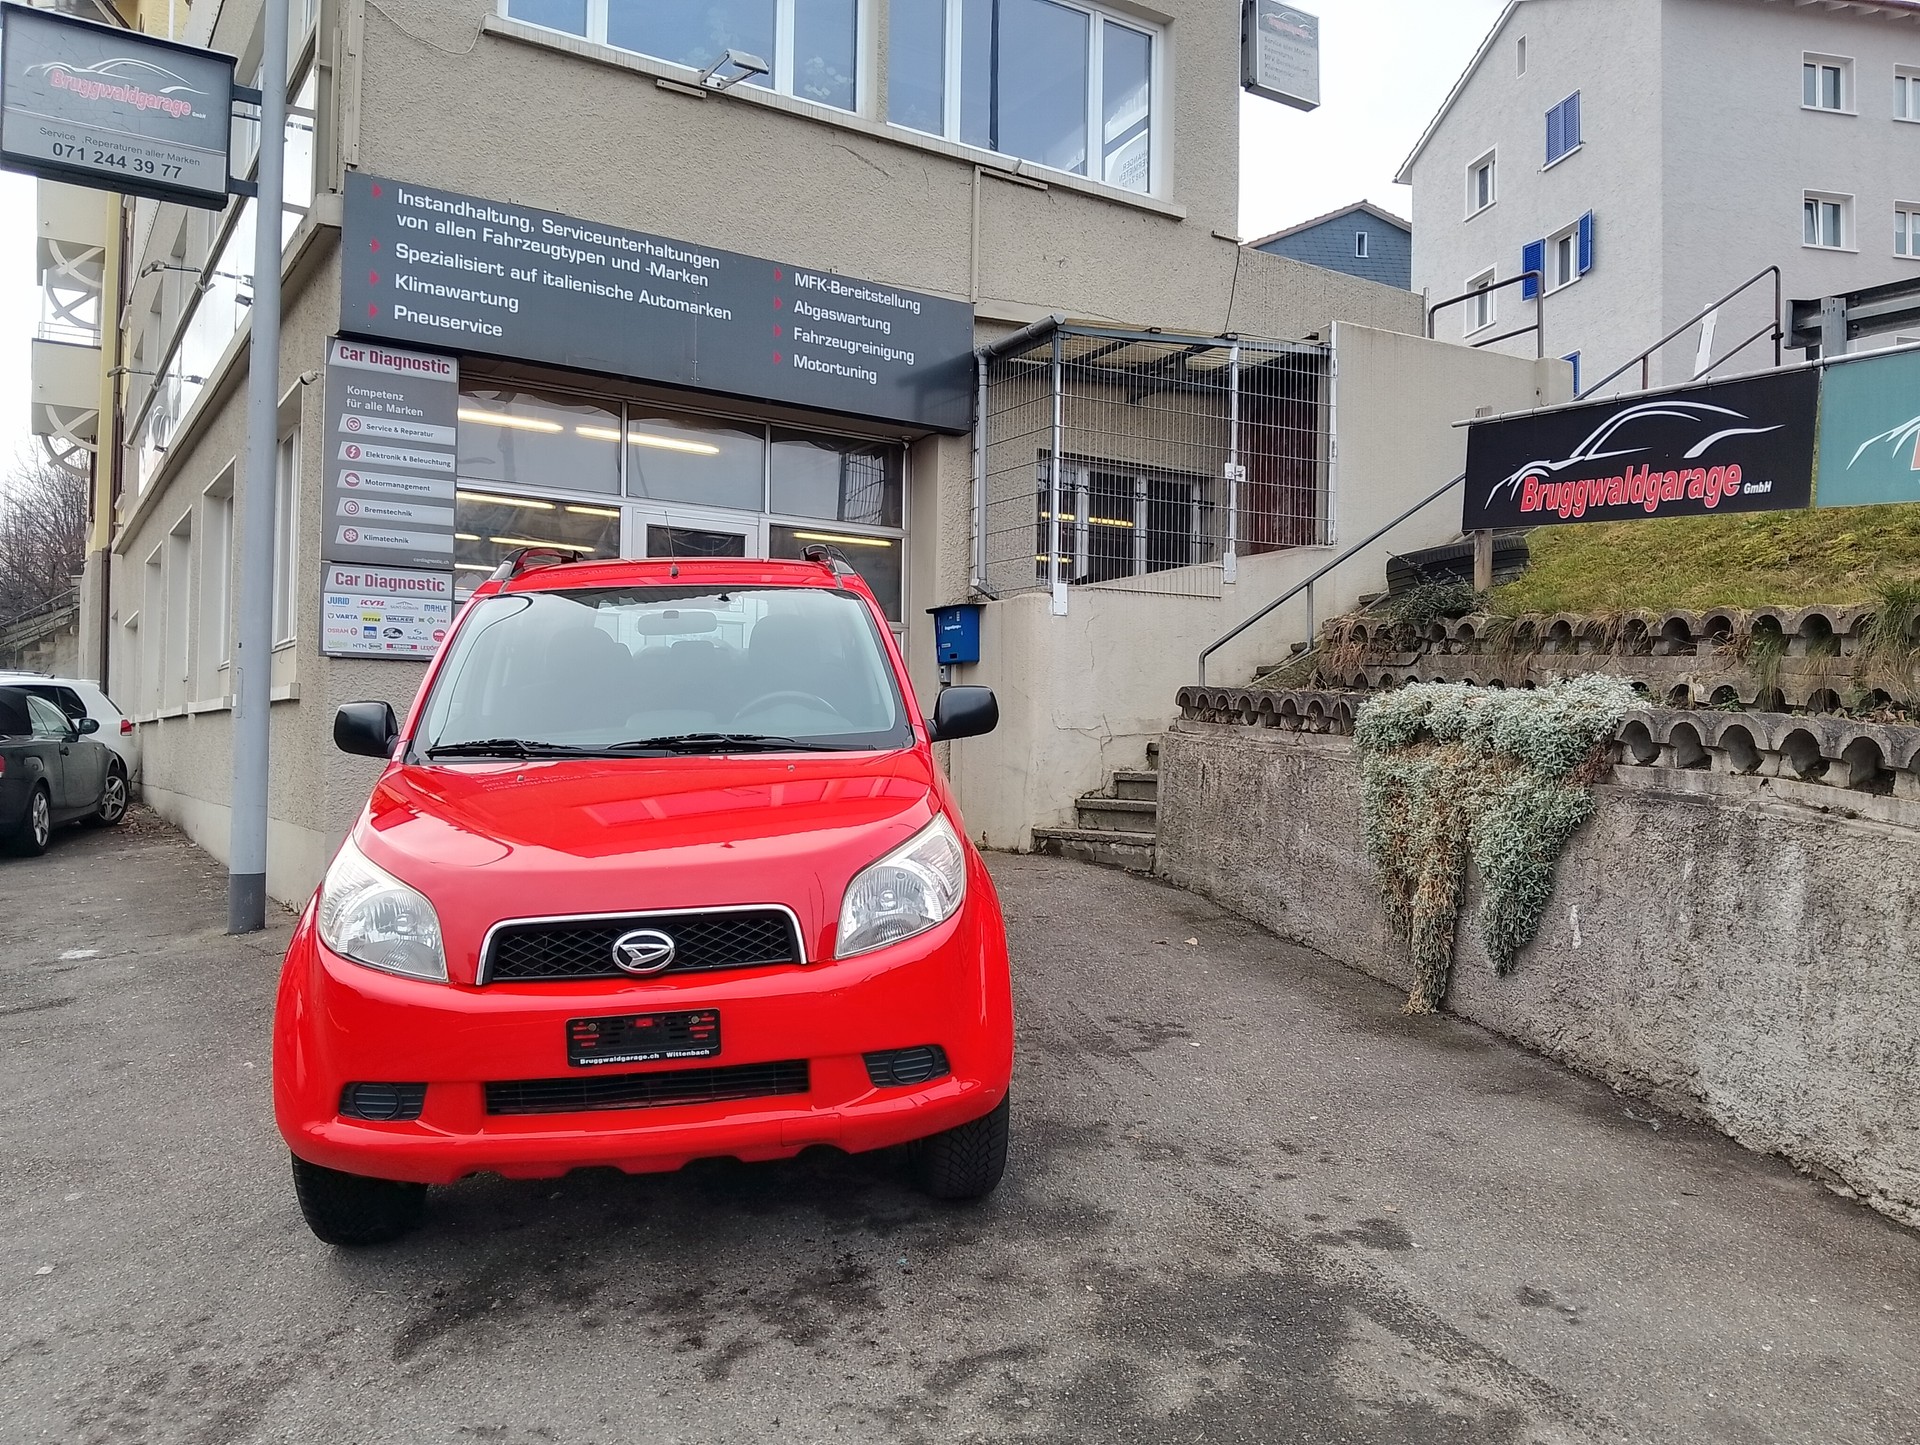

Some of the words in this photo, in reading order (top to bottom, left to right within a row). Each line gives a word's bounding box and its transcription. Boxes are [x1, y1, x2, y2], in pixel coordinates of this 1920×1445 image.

[51, 68, 192, 118] Bruggwaldgarage
[39, 127, 76, 141] Service
[145, 149, 165, 159] aller
[166, 152, 200, 166] Marken
[52, 142, 85, 161] 071
[93, 150, 127, 169] 244
[133, 158, 155, 174] 39
[161, 163, 183, 179] 77
[397, 188, 535, 233] Instandhaltung,
[542, 218, 720, 270] Serviceunterhaltungen
[396, 214, 428, 231] von
[435, 220, 476, 240] allen
[482, 227, 606, 265] Fahrzeugtypen
[611, 256, 640, 273] und
[645, 262, 709, 287] -Marken
[395, 243, 505, 277] Spezialisiert
[510, 268, 538, 283] auf
[543, 271, 634, 302] italienische
[638, 290, 732, 320] Automarken
[395, 273, 519, 313] Klimawartung
[794, 272, 921, 315] MFK-Bereitstellung
[394, 304, 503, 337] Pneuservice
[794, 300, 891, 334] Abgaswartung
[340, 346, 365, 362] Car
[369, 350, 451, 375] Diagnostic
[794, 327, 915, 366] Fahrzeugreinigung
[793, 354, 878, 385] Motortuning
[346, 398, 361, 409] für
[364, 402, 383, 412] alle
[386, 403, 424, 417] Marken
[347, 385, 404, 402] Kompetenz
[366, 423, 393, 433] Service
[394, 426, 399, 434] &
[400, 427, 434, 439] Reparatur
[365, 450, 401, 461] Elektronik
[409, 456, 452, 468] Beleuchtung
[365, 478, 431, 492] Motormanagement
[1520, 464, 1742, 519] Bruggwaldgarage
[1744, 480, 1772, 494] GmbH
[364, 506, 413, 517] Bremstechnik
[363, 534, 410, 544] Klimatechnik
[335, 572, 360, 586] Car
[364, 573, 446, 593] Diagnostic
[327, 596, 350, 606] JURID
[327, 627, 349, 635] OSRAM
[335, 613, 359, 621] VARTA
[580, 1053, 660, 1065] Bruggwaldgarage.ch
[666, 1049, 710, 1059] Wittenbach
